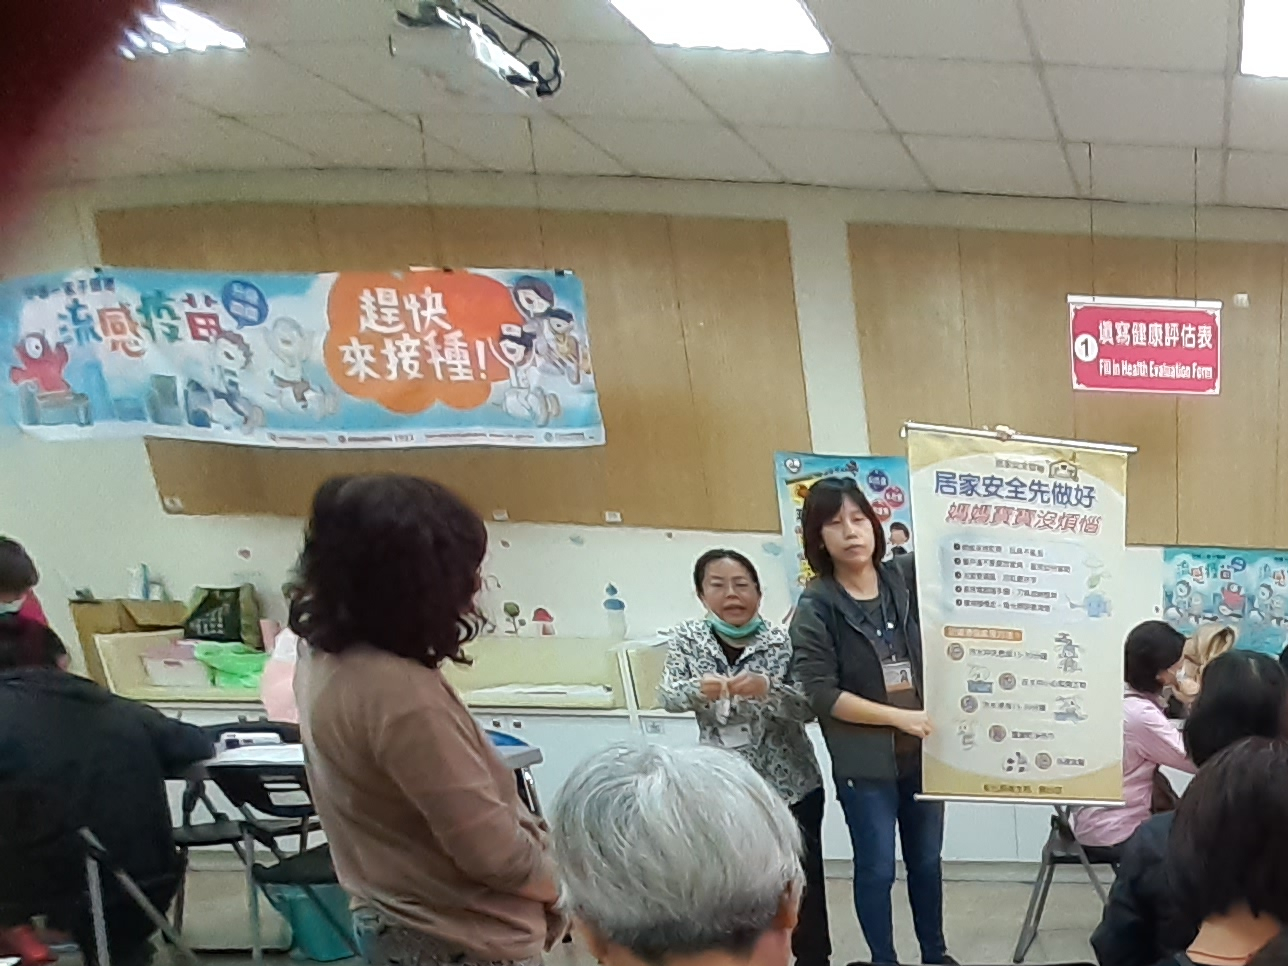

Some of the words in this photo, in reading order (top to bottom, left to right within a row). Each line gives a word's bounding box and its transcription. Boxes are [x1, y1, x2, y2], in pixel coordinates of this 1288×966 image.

[57, 289, 222, 359] 流感疫苗
[358, 286, 453, 334] 趕快
[337, 329, 487, 383] 來接種!
[1080, 338, 1090, 358] 1
[1121, 359, 1149, 378] Health
[1149, 360, 1191, 379] Evaluation
[1192, 362, 1214, 380] Form
[934, 470, 1096, 509] 居家安全先做好
[945, 501, 1102, 534] 媽媽寶寶沒煩惱
